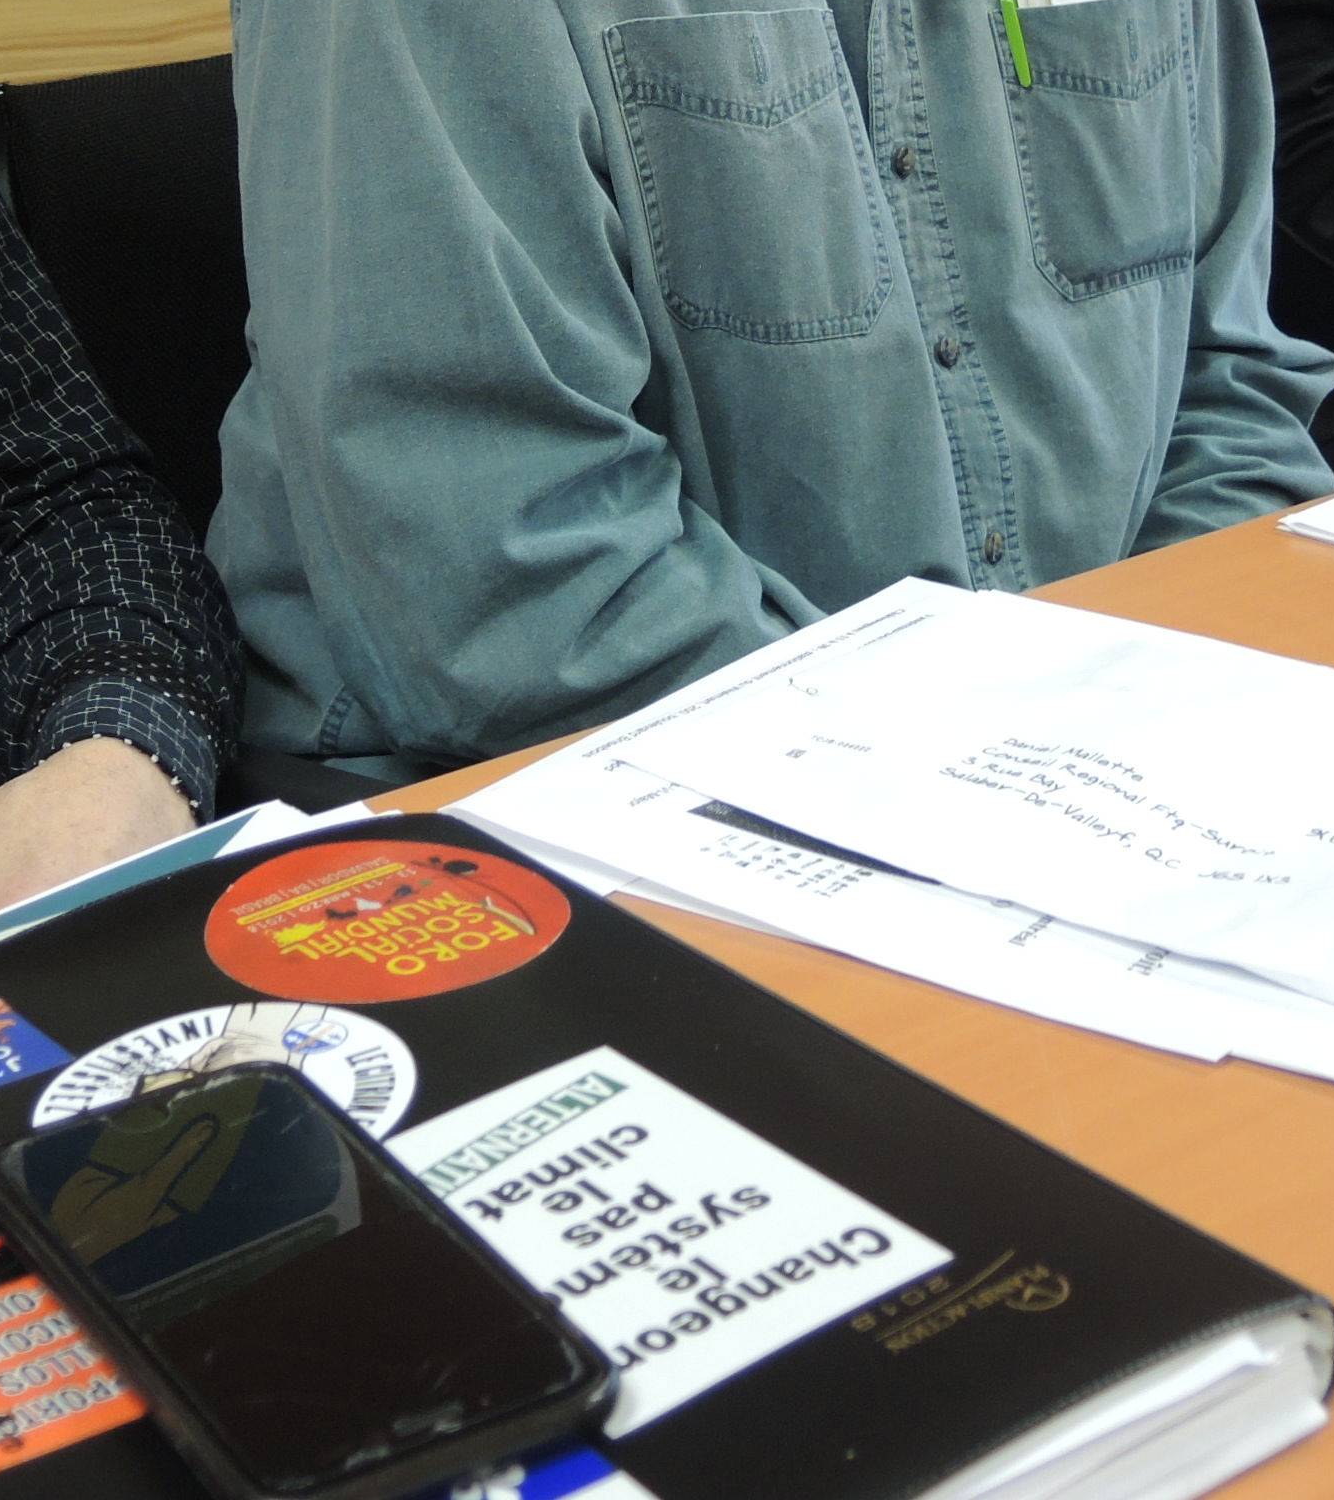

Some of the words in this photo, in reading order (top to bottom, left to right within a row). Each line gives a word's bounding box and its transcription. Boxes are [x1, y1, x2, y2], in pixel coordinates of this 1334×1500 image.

[981, 762, 1023, 778] Rue
[1029, 772, 1067, 794] Bay
[1002, 737, 1061, 754] Daniel
[1063, 747, 1144, 783] Mallette
[386, 920, 520, 976] FORO
[463, 1124, 650, 1222] climat
[540, 1178, 614, 1215] le
[561, 1181, 677, 1248] pas
[613, 1225, 892, 1372] Changeon
[654, 1255, 729, 1293] le
